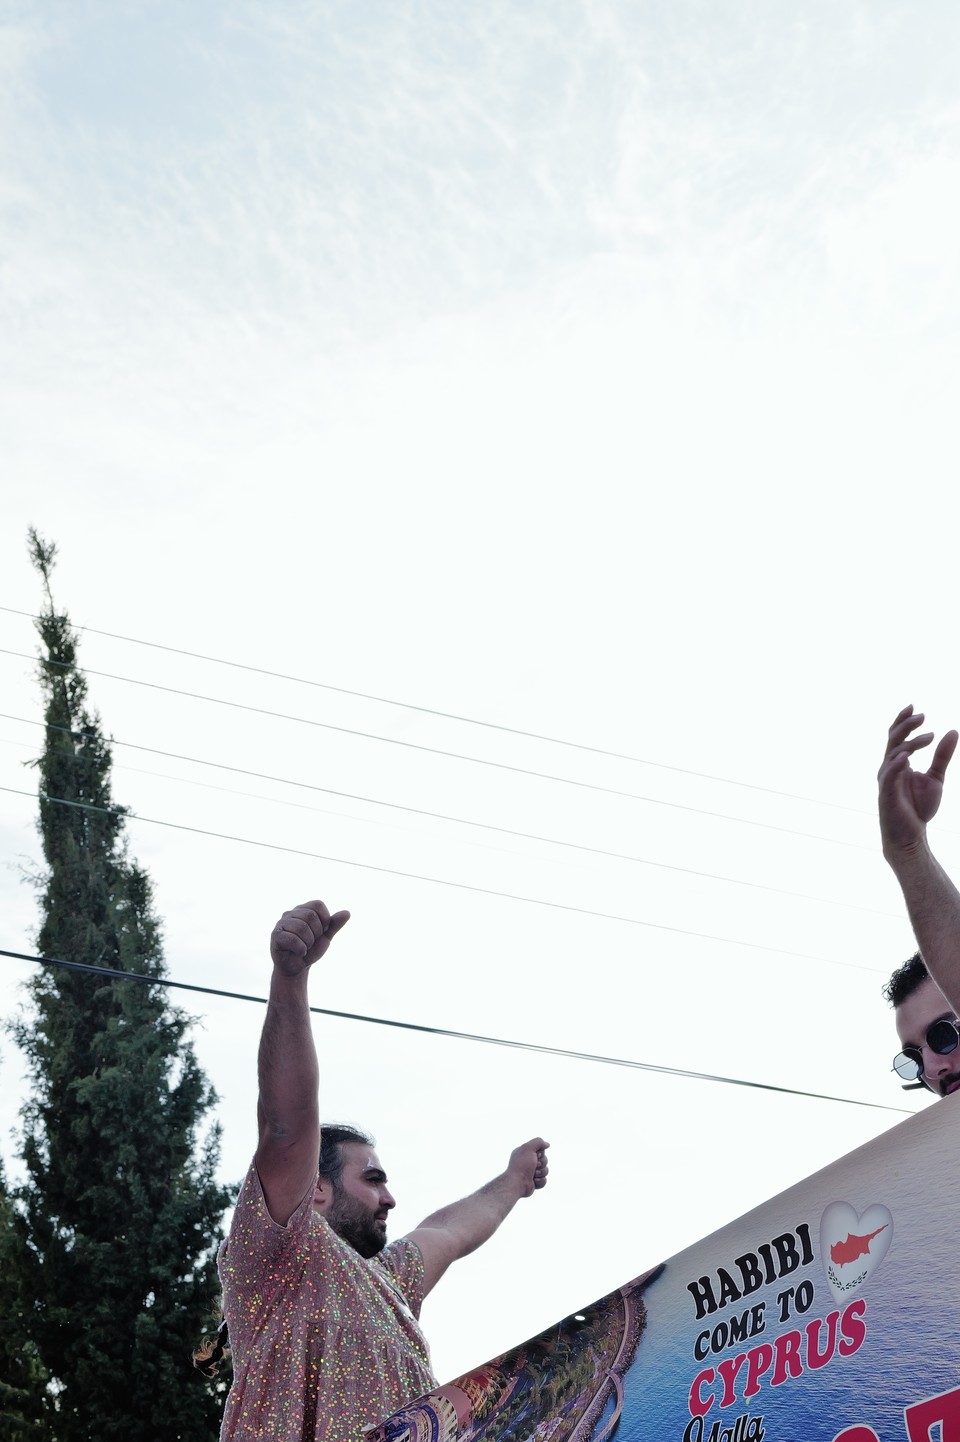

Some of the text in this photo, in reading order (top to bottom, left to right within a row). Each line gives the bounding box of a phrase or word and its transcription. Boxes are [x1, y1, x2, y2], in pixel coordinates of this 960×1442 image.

[687, 1223, 814, 1320] HABIBI
[689, 1299, 867, 1417] CYPRUS
[693, 1279, 814, 1362] COME TO
